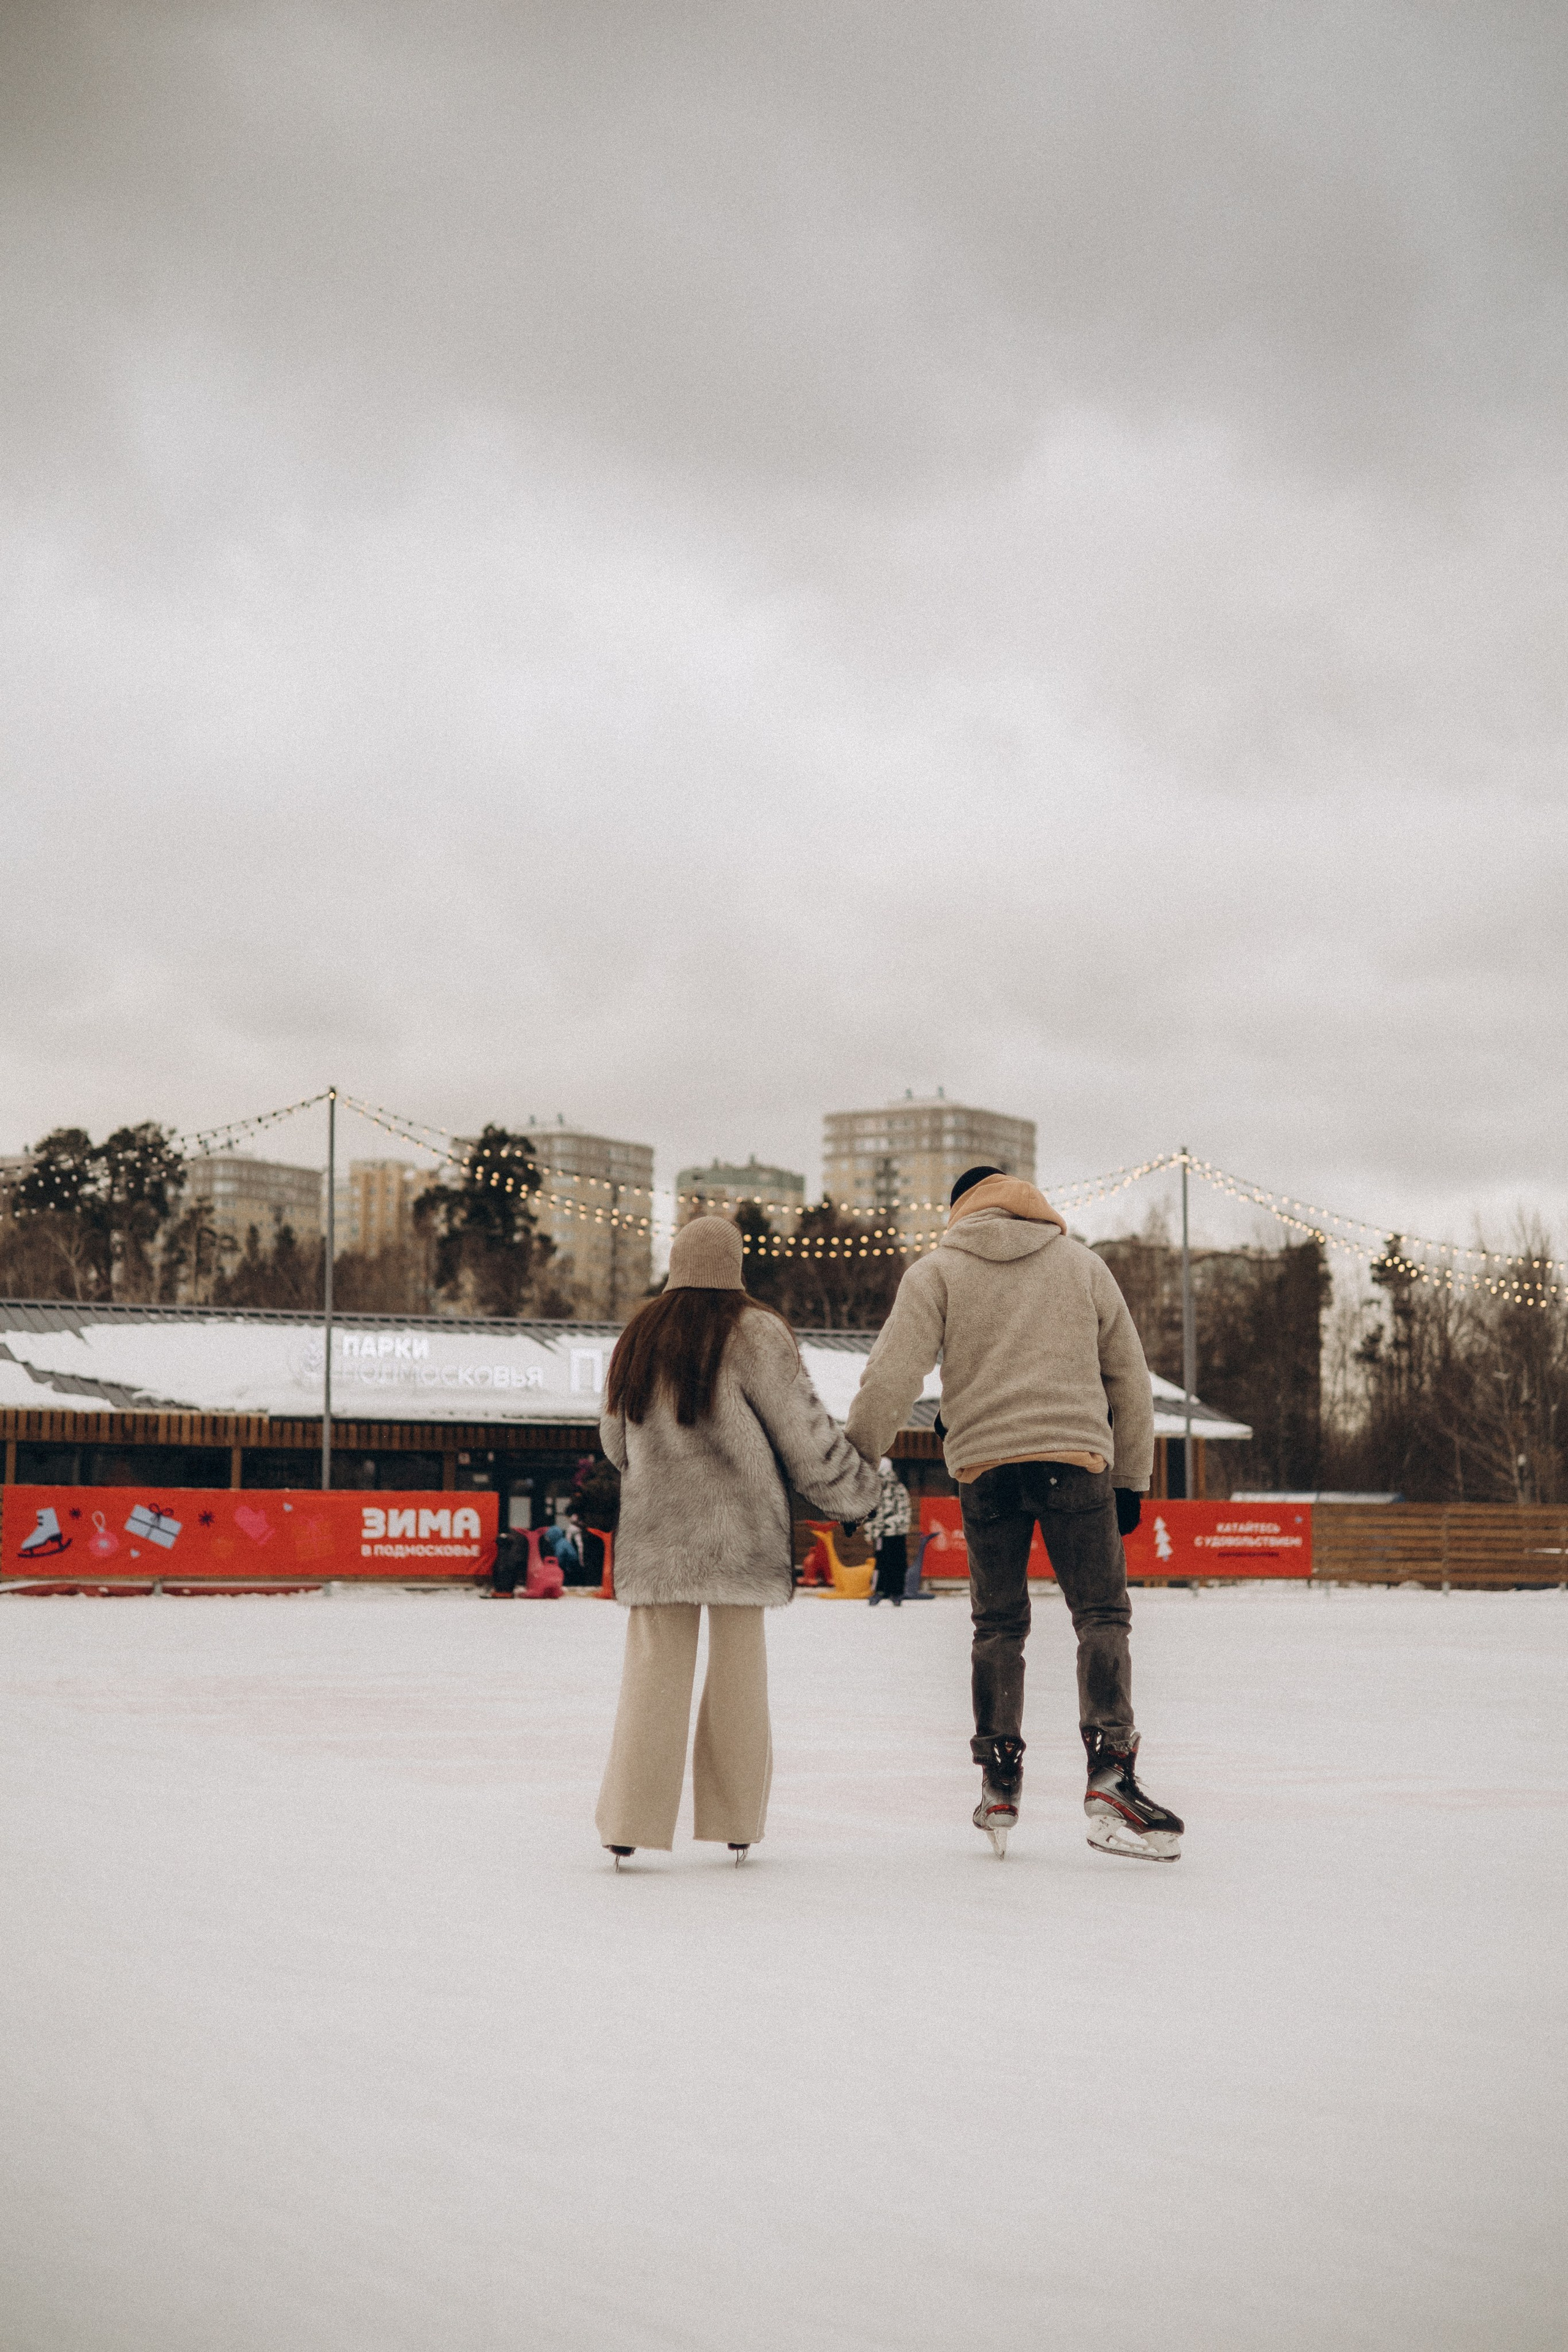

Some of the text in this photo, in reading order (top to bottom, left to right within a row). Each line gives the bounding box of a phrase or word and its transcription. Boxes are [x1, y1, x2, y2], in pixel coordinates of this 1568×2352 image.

[342, 1335, 429, 1359] ПАРКИ
[361, 1507, 481, 1539] ЗИМА
[1216, 1521, 1281, 1534] КАТАЙТЕСЬ
[1194, 1535, 1204, 1547] С
